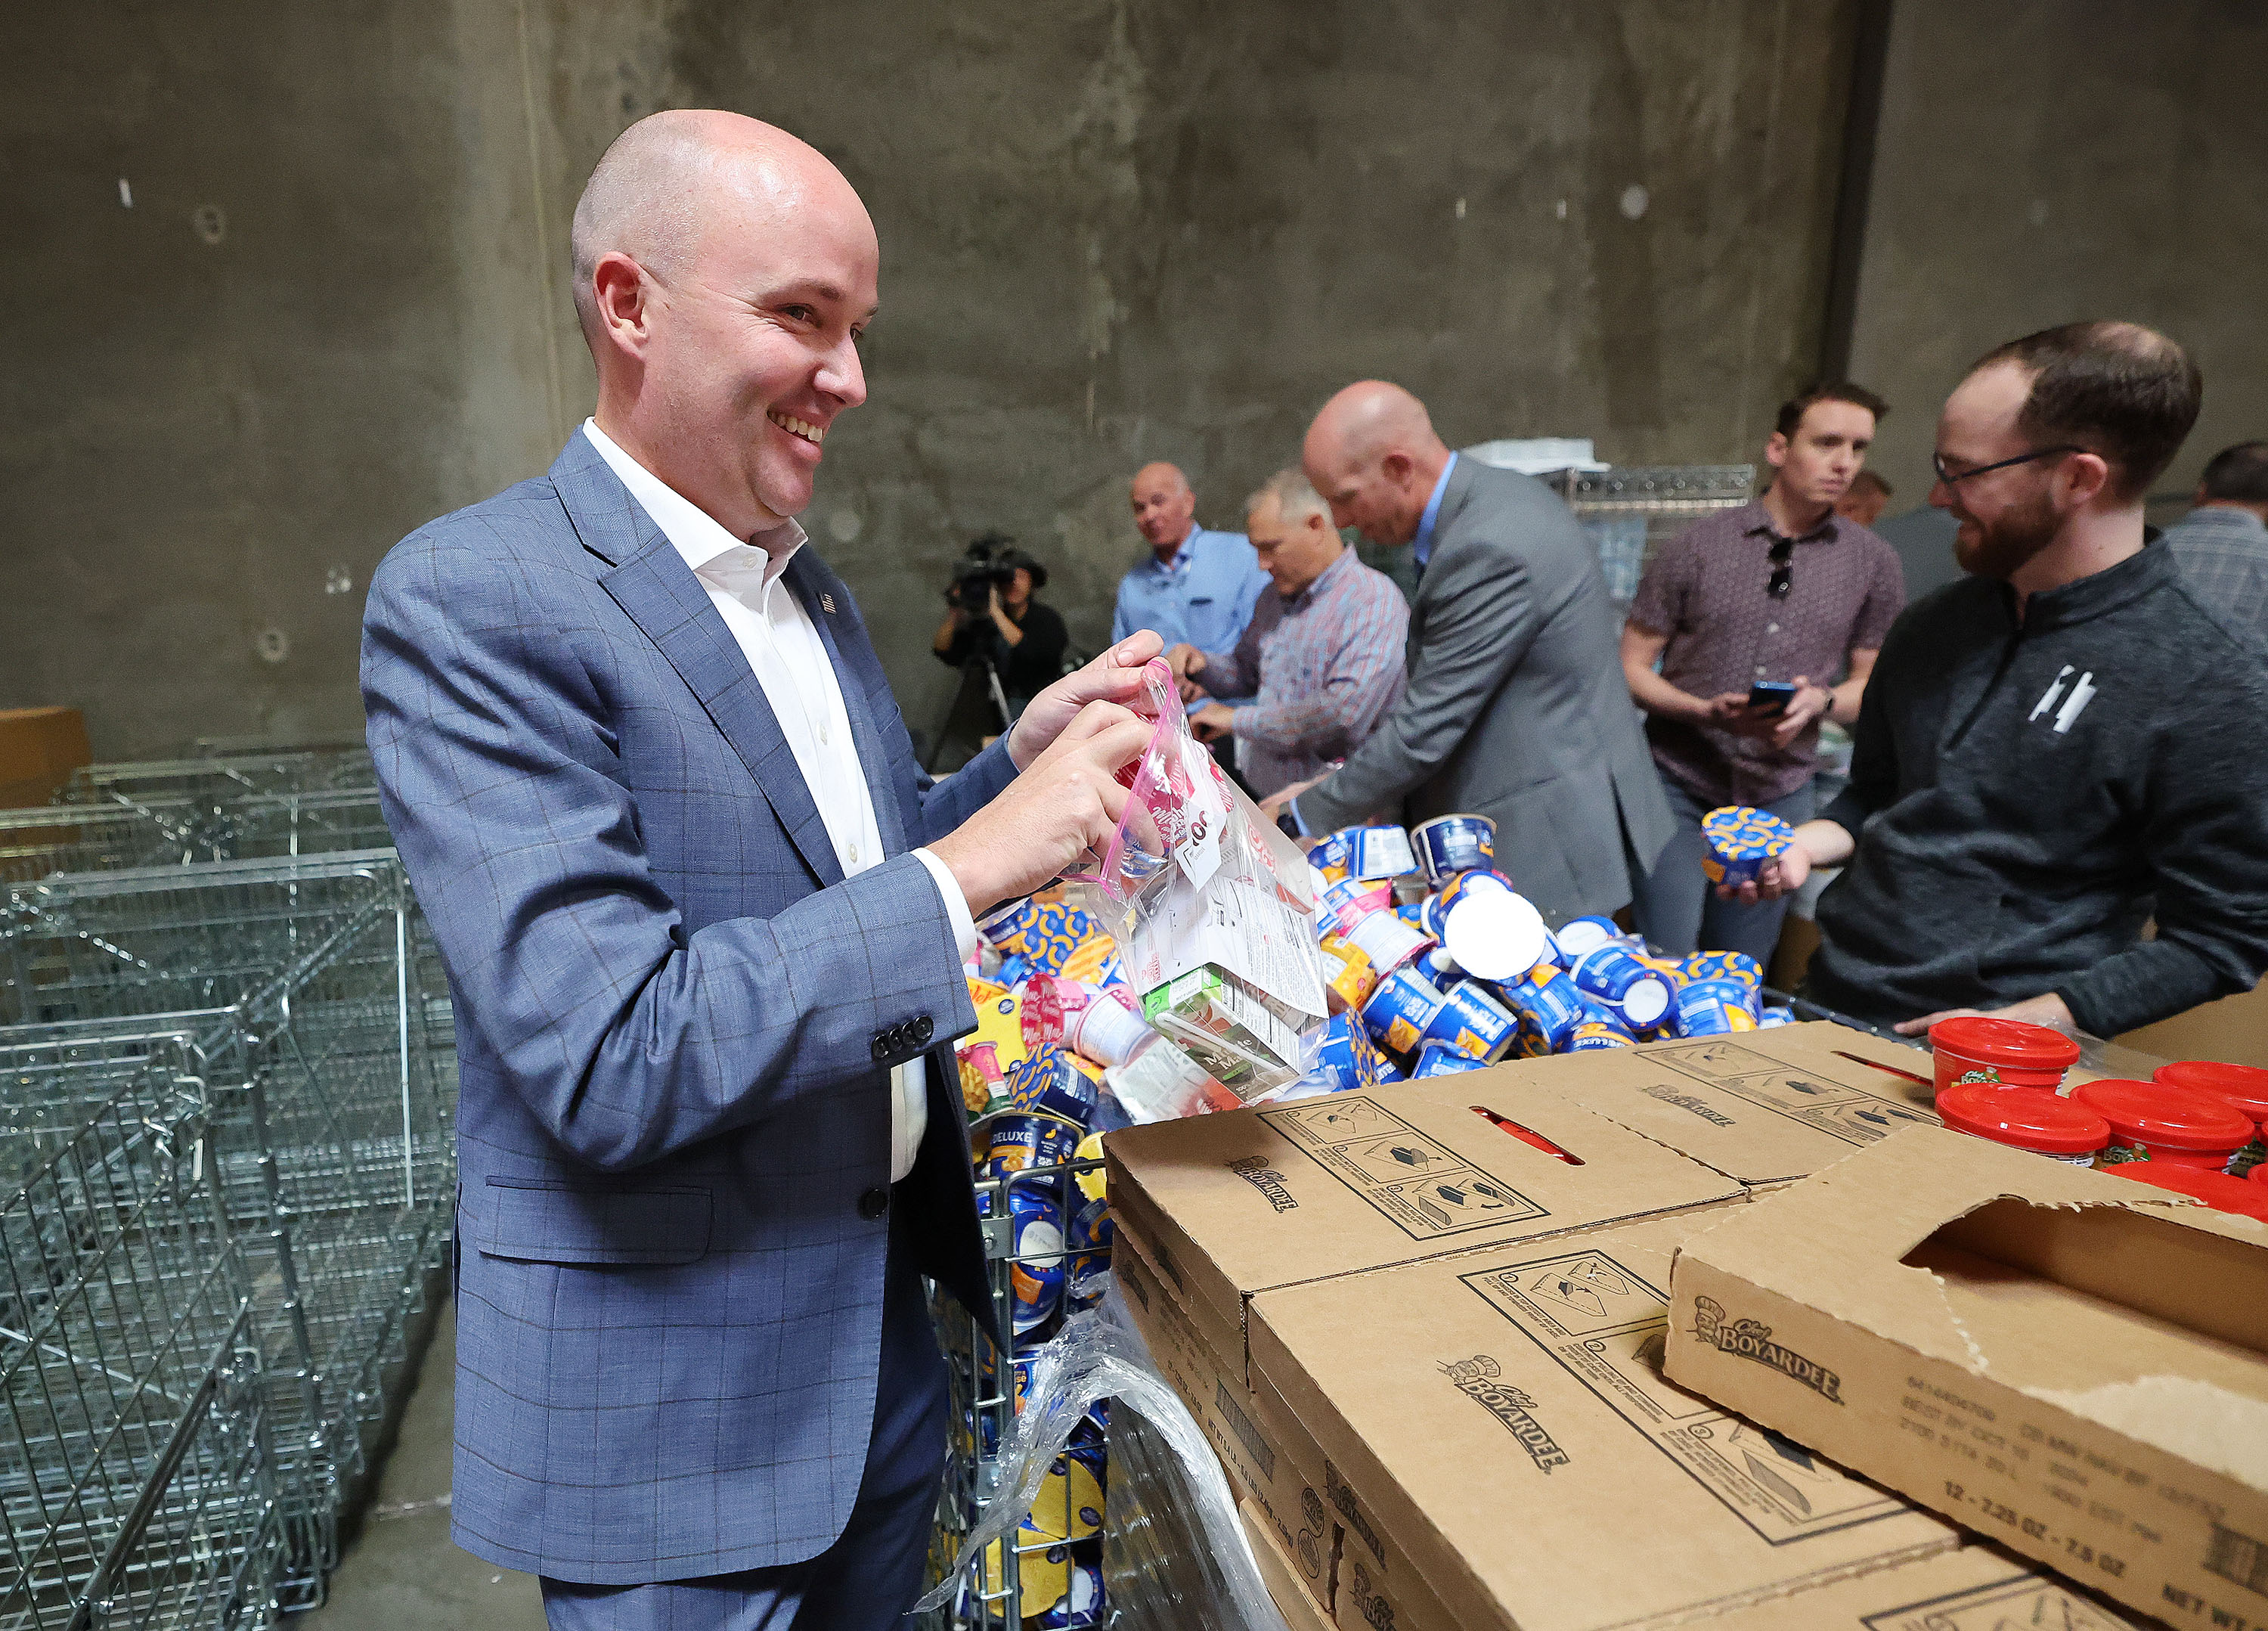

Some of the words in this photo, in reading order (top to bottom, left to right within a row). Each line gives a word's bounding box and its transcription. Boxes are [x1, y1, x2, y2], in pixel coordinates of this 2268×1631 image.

[993, 1131, 1033, 1143] DELUXE
[1234, 1167, 1299, 1213] BOYARDEE
[1718, 1326, 1840, 1404] BOYARDEE
[1454, 1378, 1571, 1471] BOYARDEE
[1944, 1479, 1964, 1502] 12
[2021, 1516, 2049, 1541] OZ
[2098, 1552, 2126, 1578] OZ
